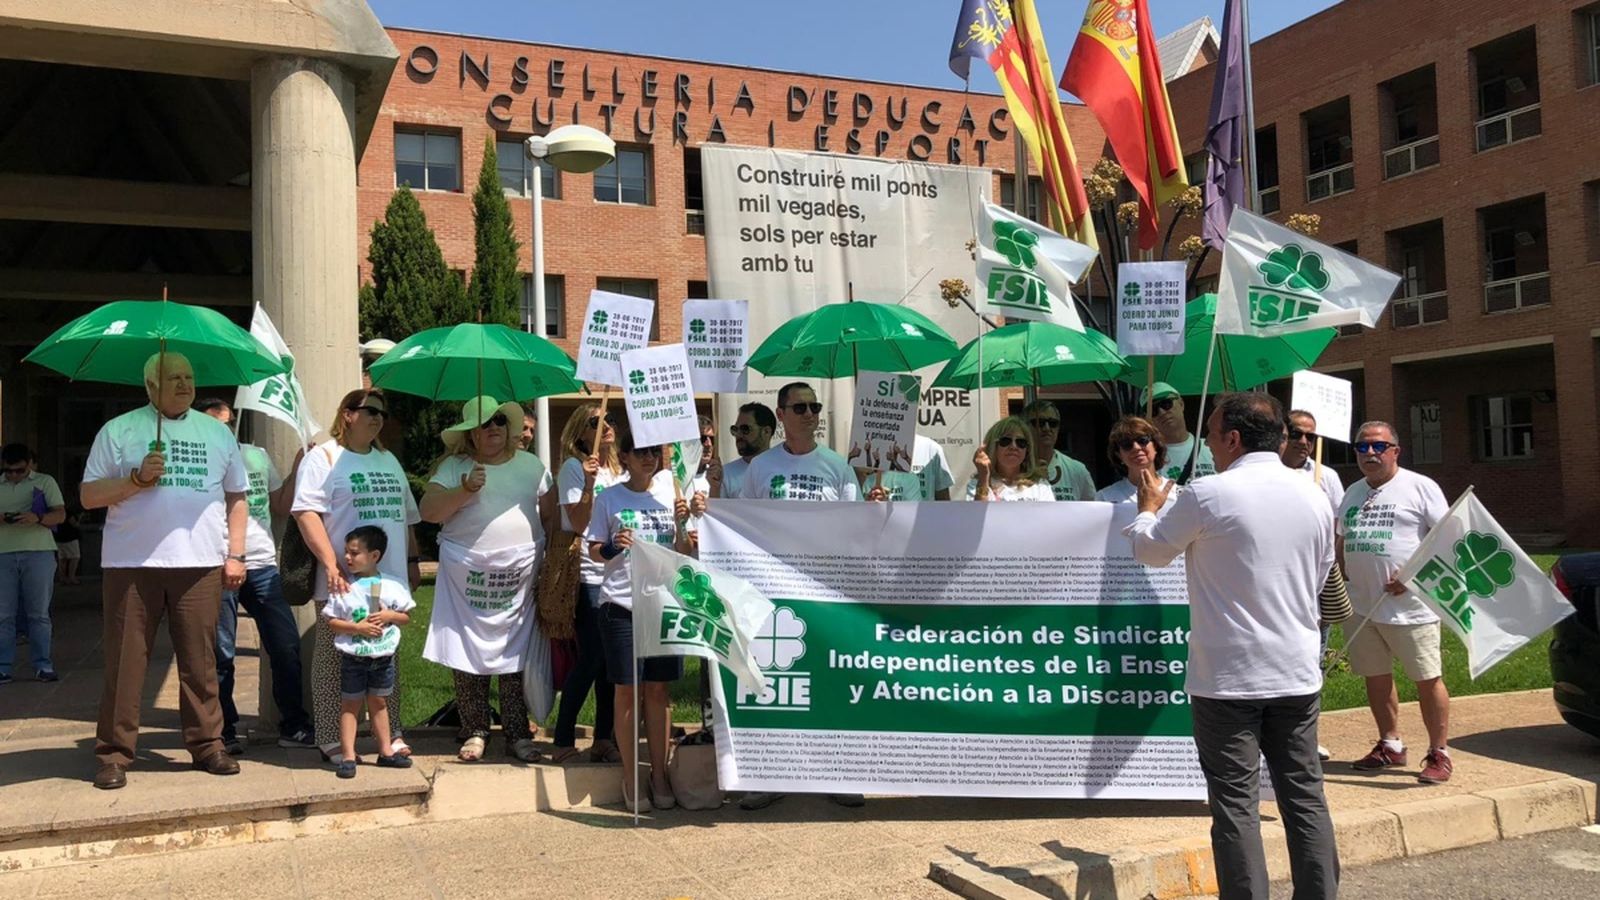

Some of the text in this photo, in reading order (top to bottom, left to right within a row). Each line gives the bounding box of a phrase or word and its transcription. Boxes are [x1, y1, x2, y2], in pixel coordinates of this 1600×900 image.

[404, 45, 1010, 140] ONSELLERIA D'EDUCAC
[814, 123, 991, 167] ESPORT
[737, 163, 938, 199] Construiré mil ponts
[739, 194, 866, 222] mil vegades,
[740, 224, 877, 248] sols per estar
[741, 253, 814, 274] amb tu
[987, 272, 1051, 310] FSIE
[1122, 309, 1179, 319] COBRO 30 JUNIO
[1248, 290, 1320, 326] FSIE
[589, 324, 608, 334] FSIE
[1129, 322, 1147, 331] PARA
[586, 336, 609, 348] COBRO
[610, 340, 620, 349] 30
[688, 334, 707, 343] FSIE
[591, 349, 609, 360] PARA
[688, 347, 743, 357] COBRO 30 JUNIO
[694, 360, 712, 368] PARA
[260, 379, 294, 412] FS
[629, 384, 649, 394] FSIE
[877, 377, 895, 397] SÍ
[632, 392, 689, 409] COBRO 30 JUNIO
[865, 397, 871, 407] la
[873, 399, 899, 410] defensa
[901, 402, 909, 411] de
[920, 389, 971, 407] MPRE
[641, 410, 659, 420] PARA
[862, 407, 904, 421] la enseñanza
[918, 409, 946, 426] UA
[864, 420, 900, 431] concertada
[871, 431, 896, 442] privada
[186, 466, 208, 476] JUNIO
[1369, 531, 1393, 540] JUNIO
[1416, 559, 1475, 633] FSIE
[661, 611, 733, 655] FSIE
[875, 623, 1192, 645] Federación de Sindicat
[829, 649, 1188, 675] Independientes de la Ense
[849, 680, 1191, 709] y Atención a la Discapaci
